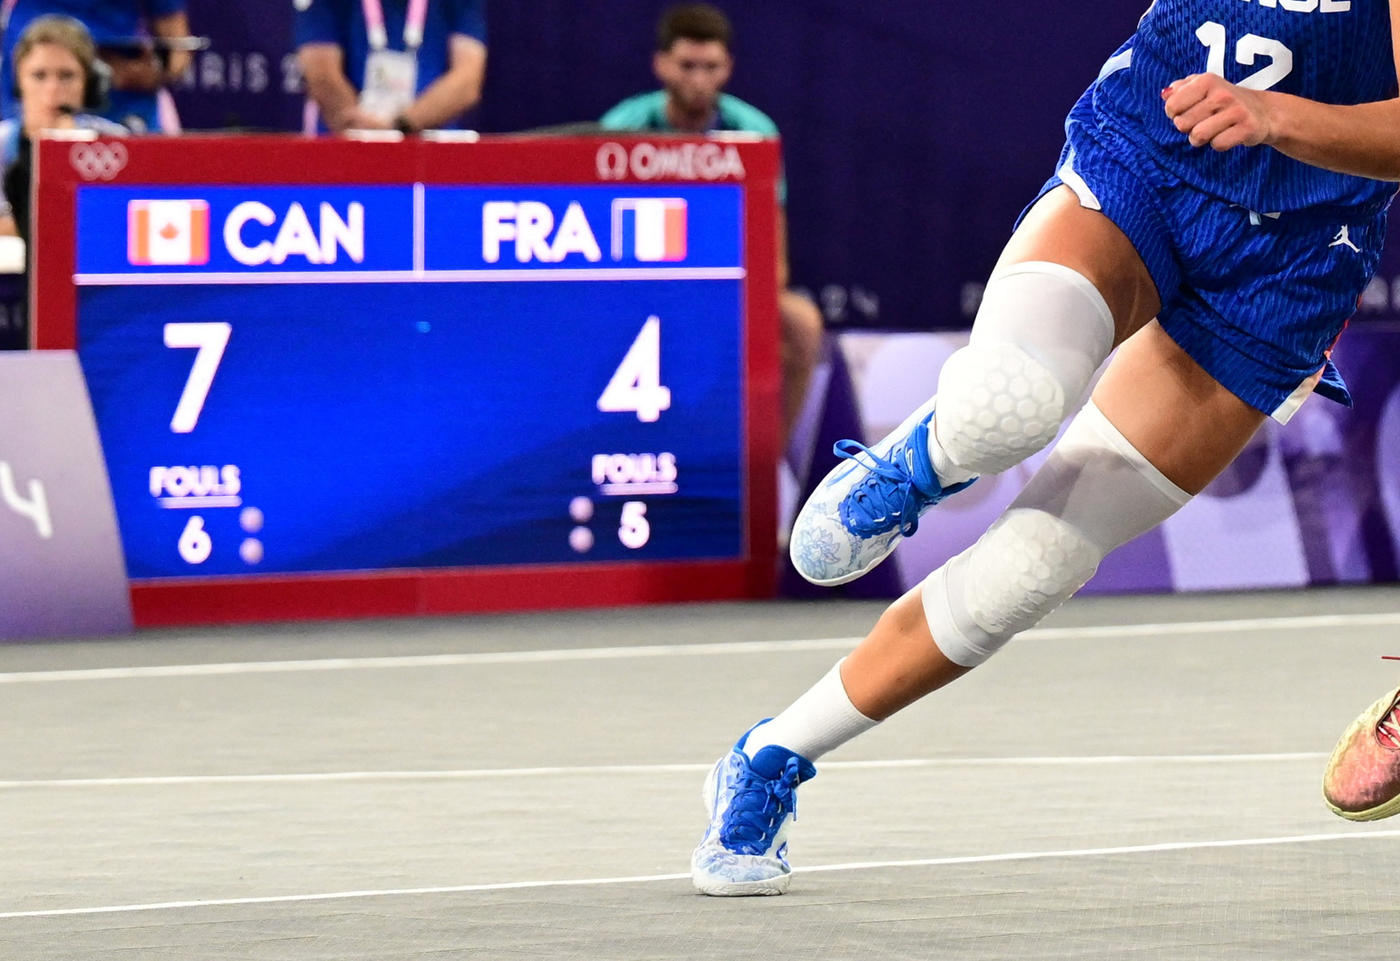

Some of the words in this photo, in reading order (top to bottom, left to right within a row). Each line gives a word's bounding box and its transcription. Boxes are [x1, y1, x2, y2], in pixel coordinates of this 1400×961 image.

[1195, 20, 1293, 91] 12
[629, 142, 746, 180] OMEGA
[223, 201, 364, 265] CAN
[482, 201, 601, 263] FRA
[163, 322, 232, 433] 7
[597, 316, 671, 422] 4
[150, 465, 240, 495] FOULS
[592, 454, 677, 484] FOULS
[178, 515, 211, 564] 6
[618, 502, 650, 549] 5
